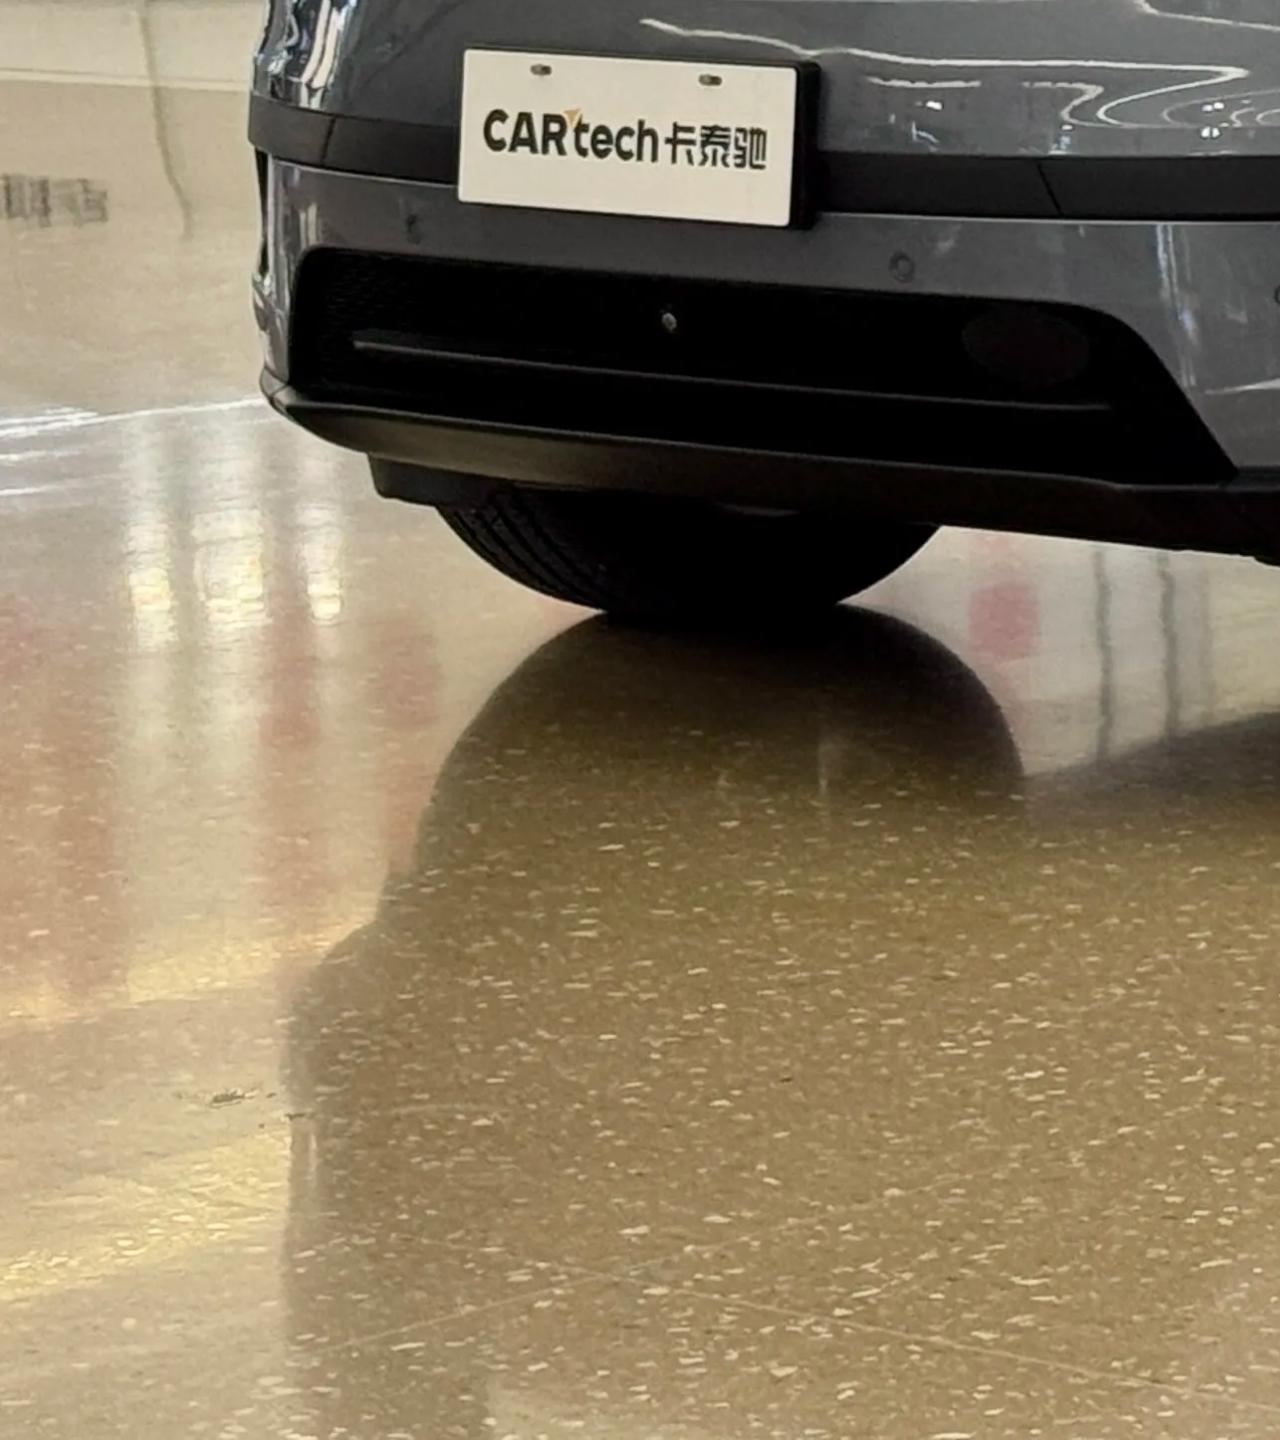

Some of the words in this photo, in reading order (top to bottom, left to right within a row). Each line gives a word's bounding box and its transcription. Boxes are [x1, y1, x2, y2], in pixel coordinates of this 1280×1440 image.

[482, 108, 660, 164] CARtech
[664, 120, 768, 171] 卡泰驰
